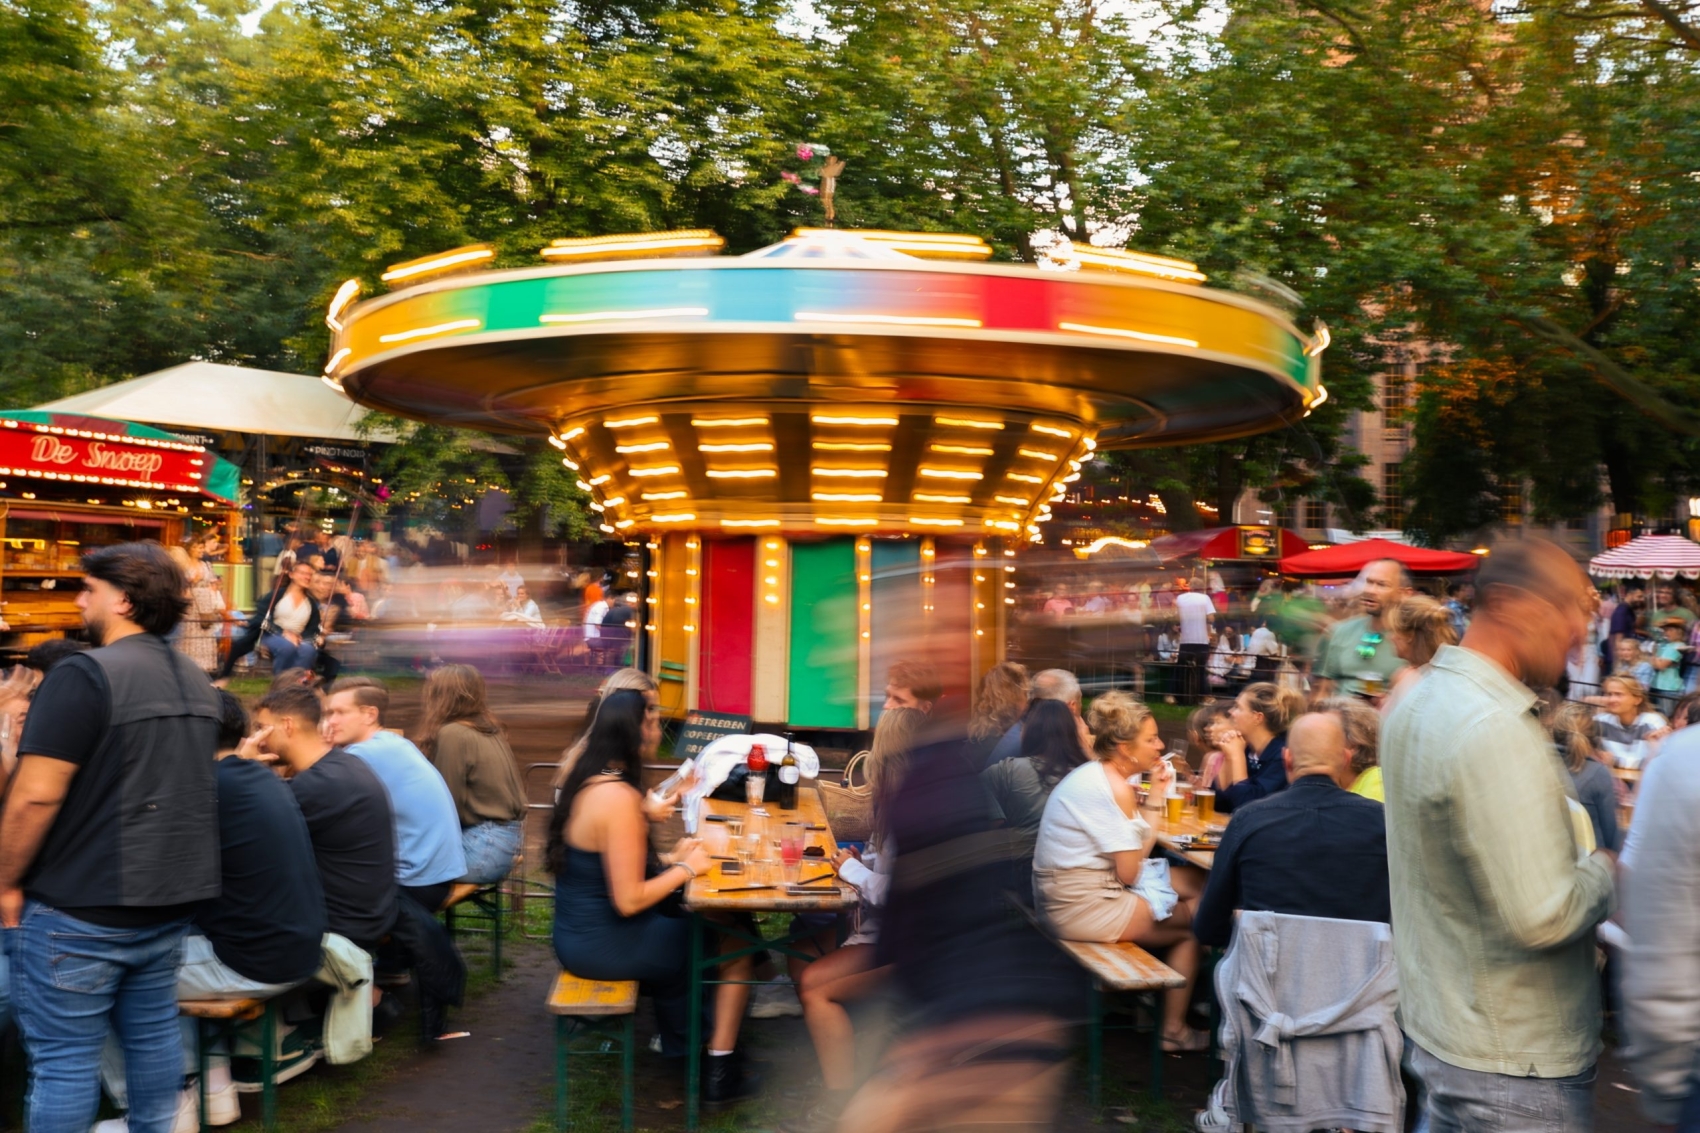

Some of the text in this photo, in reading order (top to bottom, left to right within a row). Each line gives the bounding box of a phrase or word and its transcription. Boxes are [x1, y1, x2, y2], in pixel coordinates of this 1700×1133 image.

[30, 434, 163, 481] De Snoep
[314, 445, 341, 458] PINOT
[687, 716, 747, 730] BETREDEN
